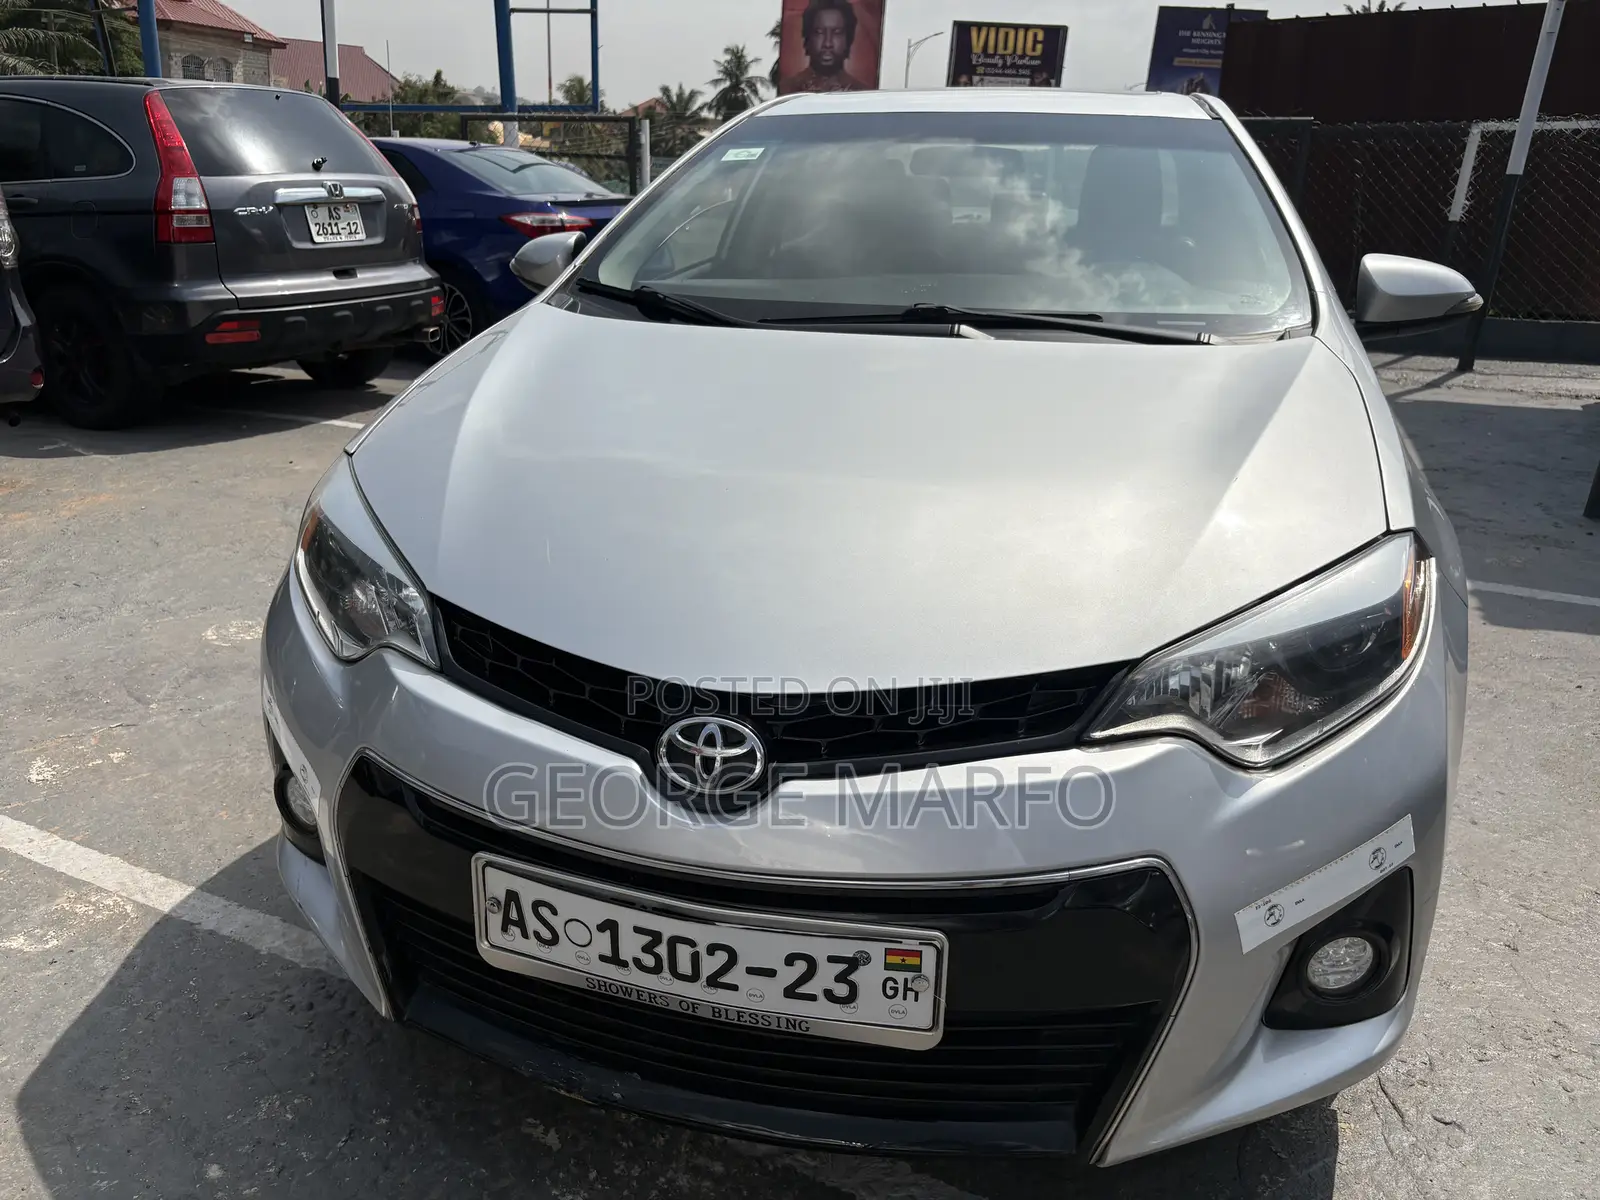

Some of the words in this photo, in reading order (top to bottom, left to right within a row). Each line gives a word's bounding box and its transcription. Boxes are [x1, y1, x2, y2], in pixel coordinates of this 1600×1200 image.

[970, 26, 1044, 56] VIDIC
[233, 206, 274, 215] CR-V
[327, 206, 341, 221] AS
[315, 222, 360, 236] 2611-12
[501, 888, 560, 946] AS
[596, 918, 859, 1004] 1302-23
[882, 976, 920, 1002] GH
[585, 977, 669, 1007] SHOWERS
[679, 1000, 700, 1014] OF
[711, 1005, 810, 1032] BLESSING
